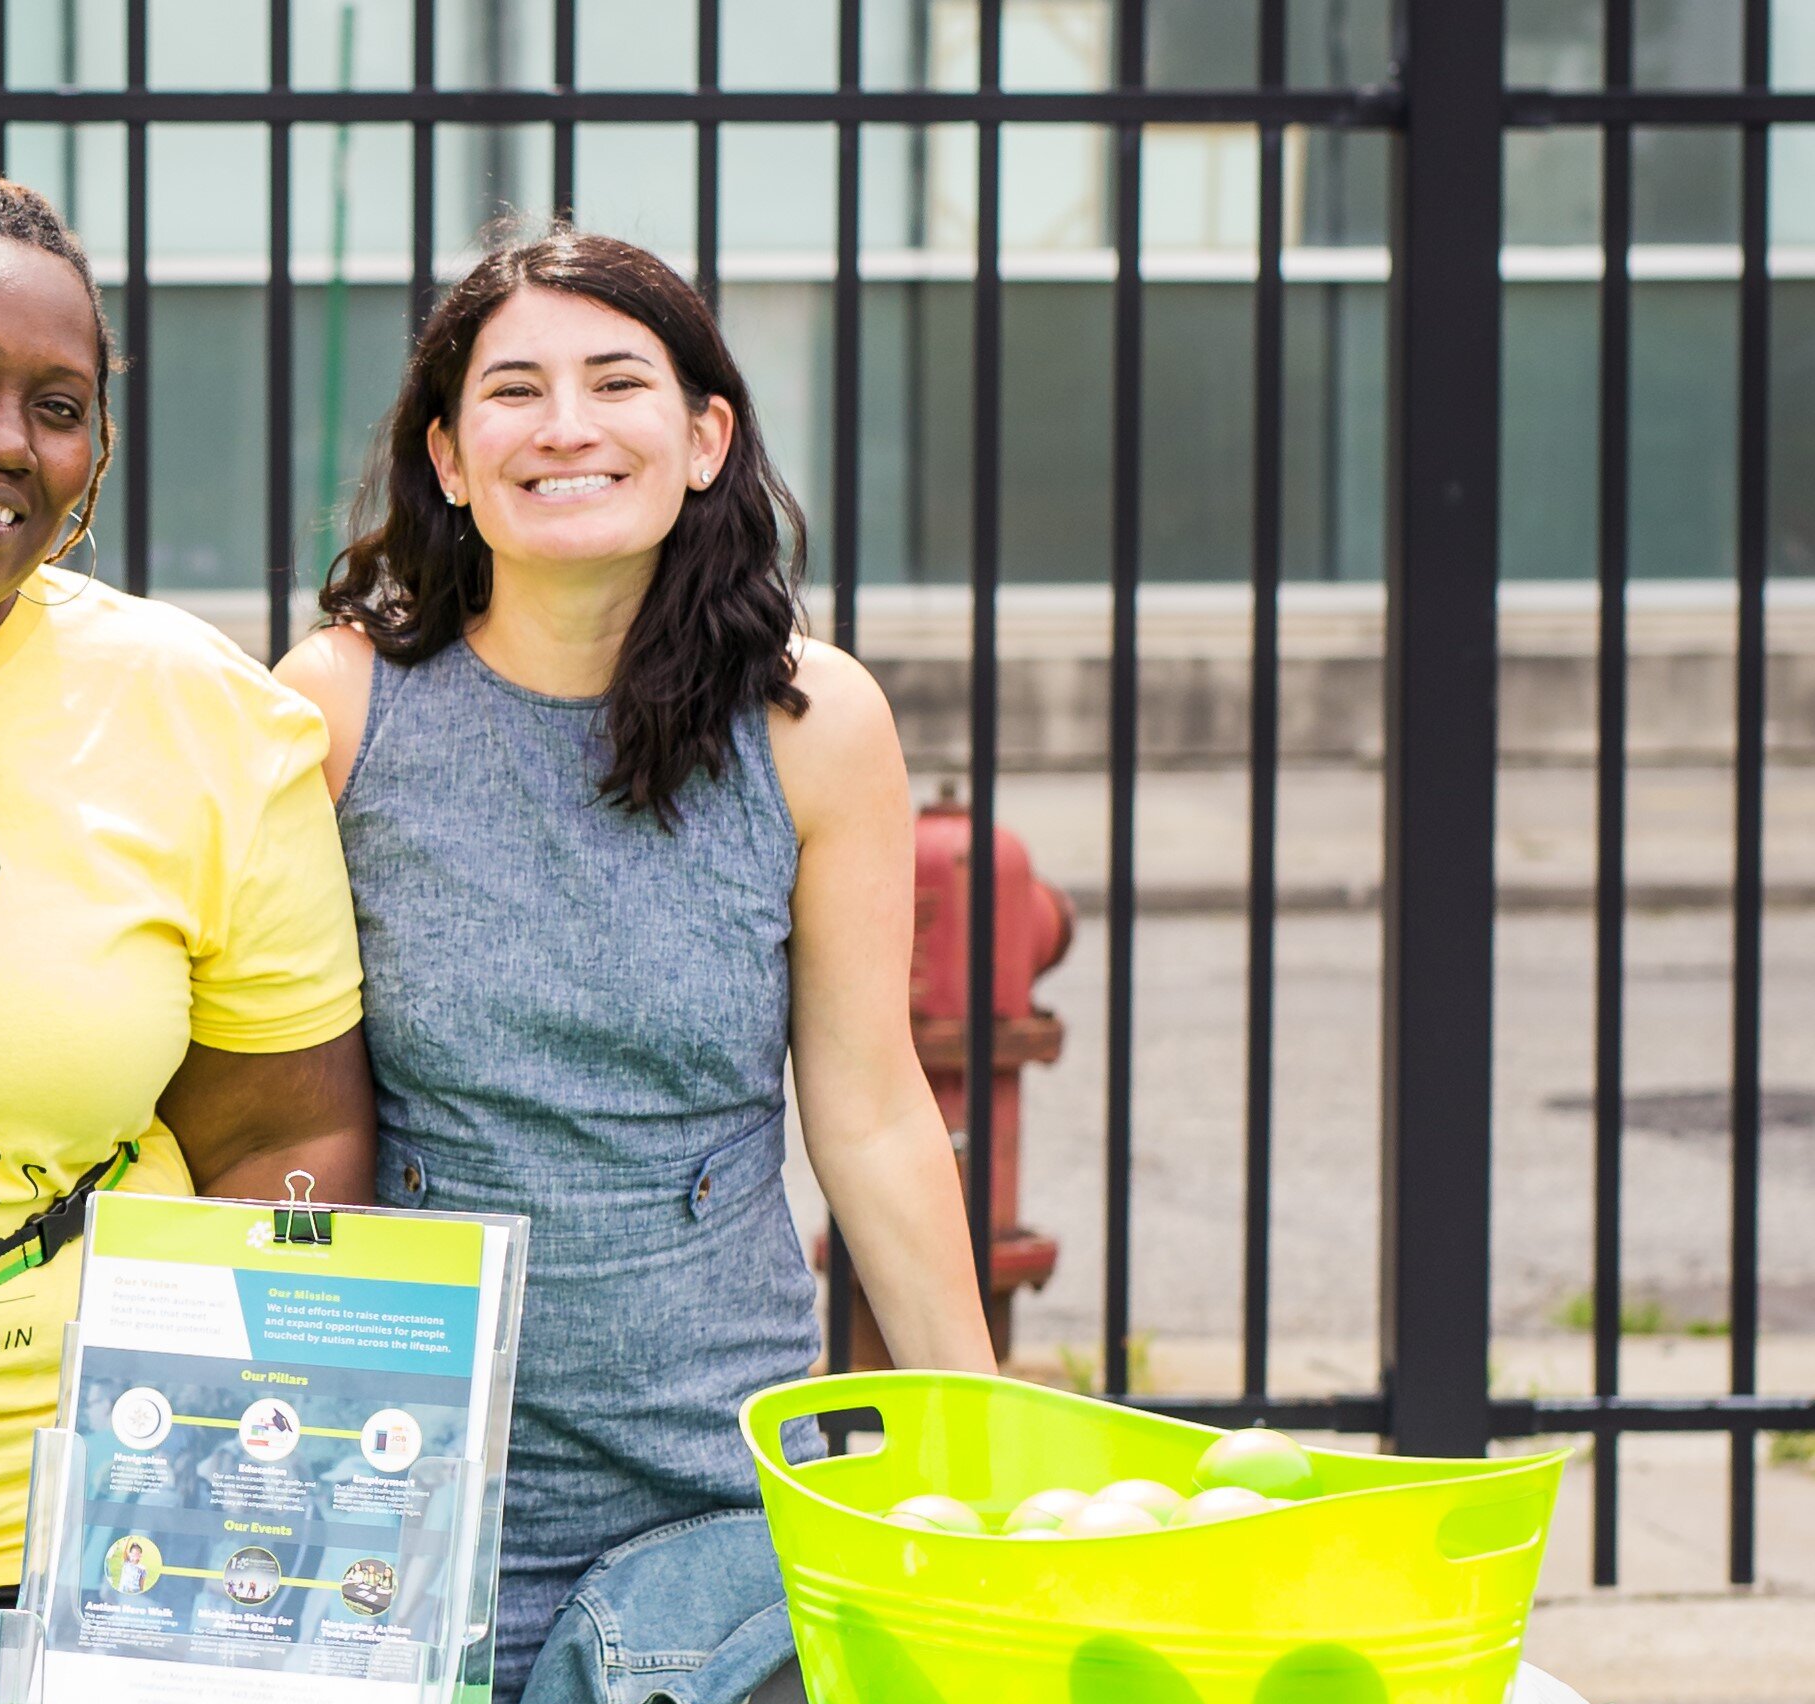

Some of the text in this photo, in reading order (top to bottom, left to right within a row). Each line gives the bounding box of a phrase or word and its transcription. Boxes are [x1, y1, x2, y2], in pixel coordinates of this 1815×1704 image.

[268, 1288, 341, 1302] Our Mission
[267, 1303, 444, 1326] We lead efforts to raise expectations
[265, 1317, 446, 1340] and expand opportunities for people
[264, 1330, 451, 1354] touched by autism across the lifespan.
[241, 1369, 309, 1386] Our Pillars
[113, 1452, 168, 1466] Navigation
[238, 1463, 287, 1477] Education
[224, 1519, 293, 1536] Our Events
